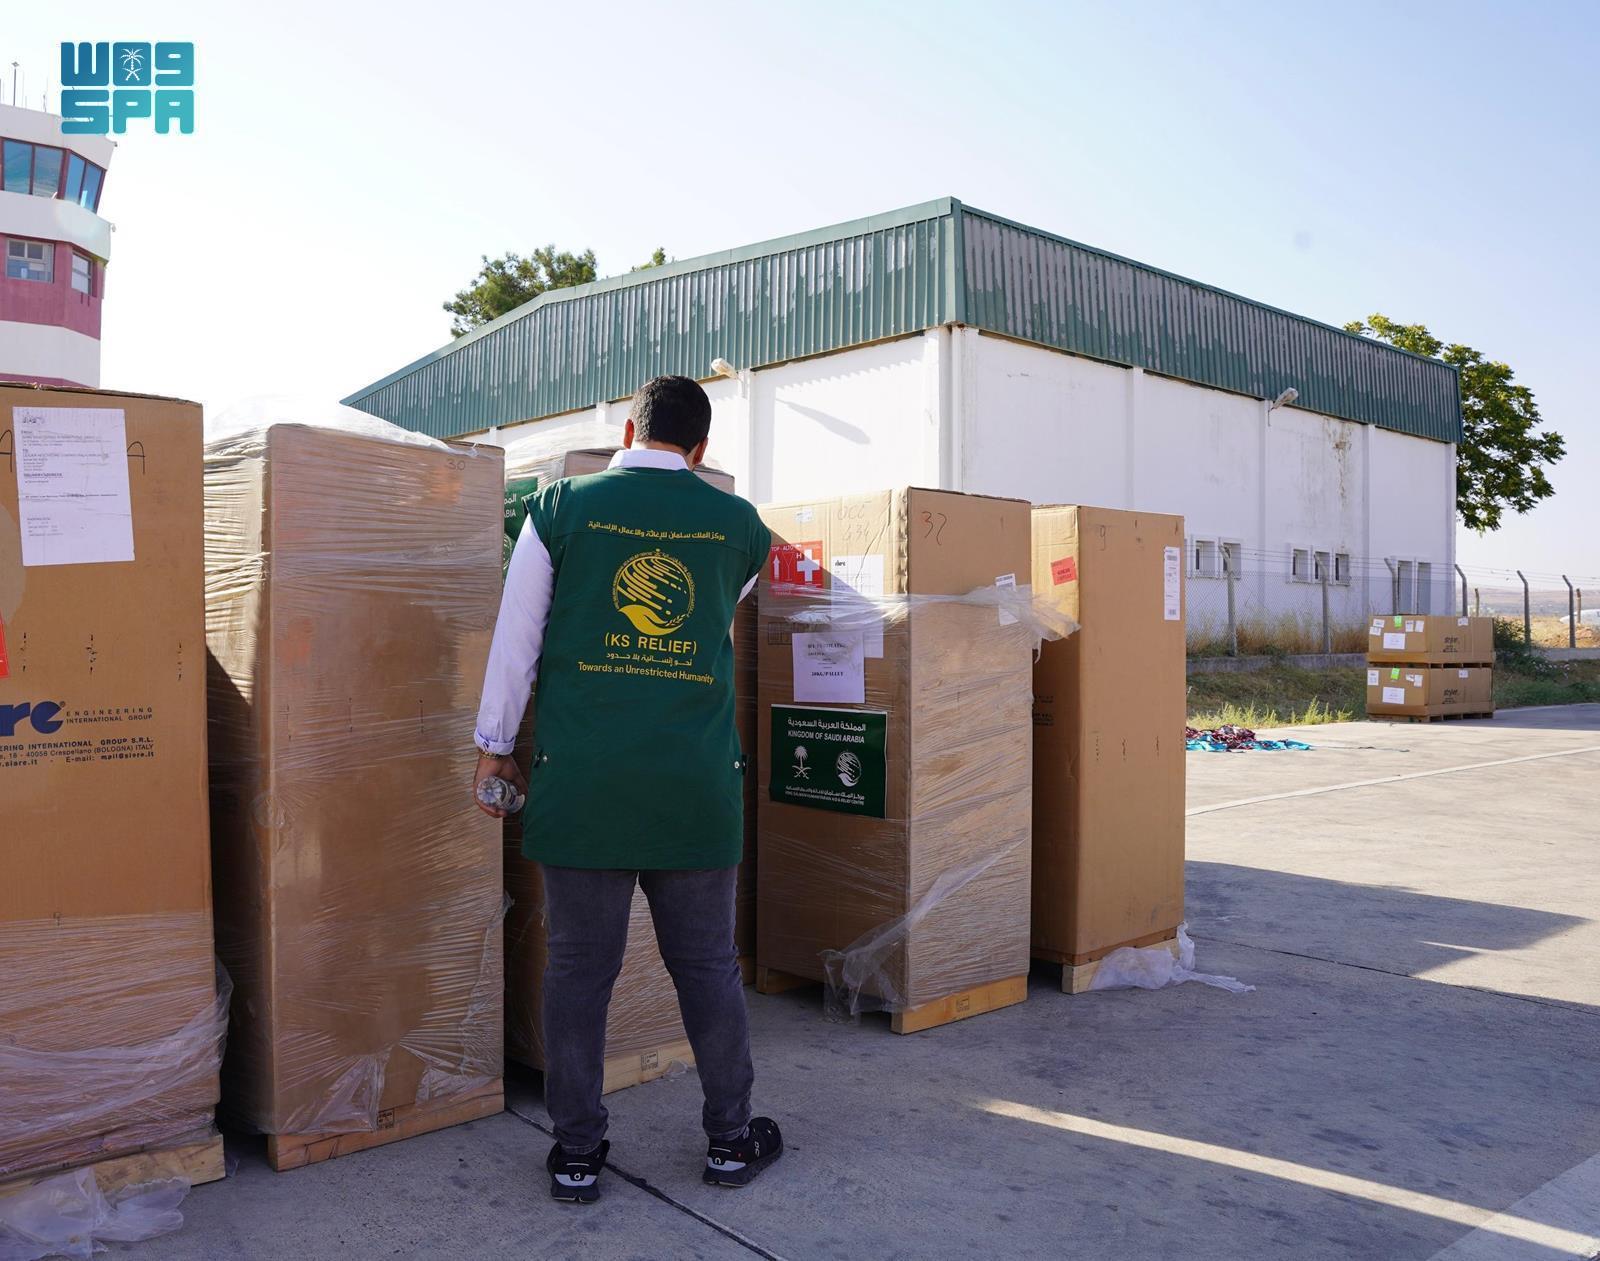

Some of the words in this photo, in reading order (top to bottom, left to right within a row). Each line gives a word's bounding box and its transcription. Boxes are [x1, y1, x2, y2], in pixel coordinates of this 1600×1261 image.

[668, 530, 691, 540] سلمان
[692, 531, 710, 540] الملك
[605, 632, 630, 647] (KS
[638, 635, 697, 655] RELIEF)
[578, 661, 612, 673] Towards
[614, 665, 624, 673] an
[625, 665, 678, 679] Unrestricted
[679, 670, 714, 684] Humanity
[66, 707, 153, 717] ENGINEERING
[66, 716, 123, 724] INTERNATIONAL
[787, 717, 817, 728] السعودية
[818, 719, 840, 730] العربية
[840, 720, 867, 732] المملكة
[788, 730, 815, 739] KINGDOM
[815, 732, 823, 740] OF
[824, 733, 841, 742] SAUDI
[842, 735, 865, 744] ARABIA
[28, 740, 93, 750] INTERNATIONAL
[100, 738, 128, 746] GROUP
[93, 745, 133, 754] (BOLOGNA)
[135, 743, 154, 751] ITALY
[0, 759, 38, 768] .siare.it
[66, 755, 95, 763] E-mail:
